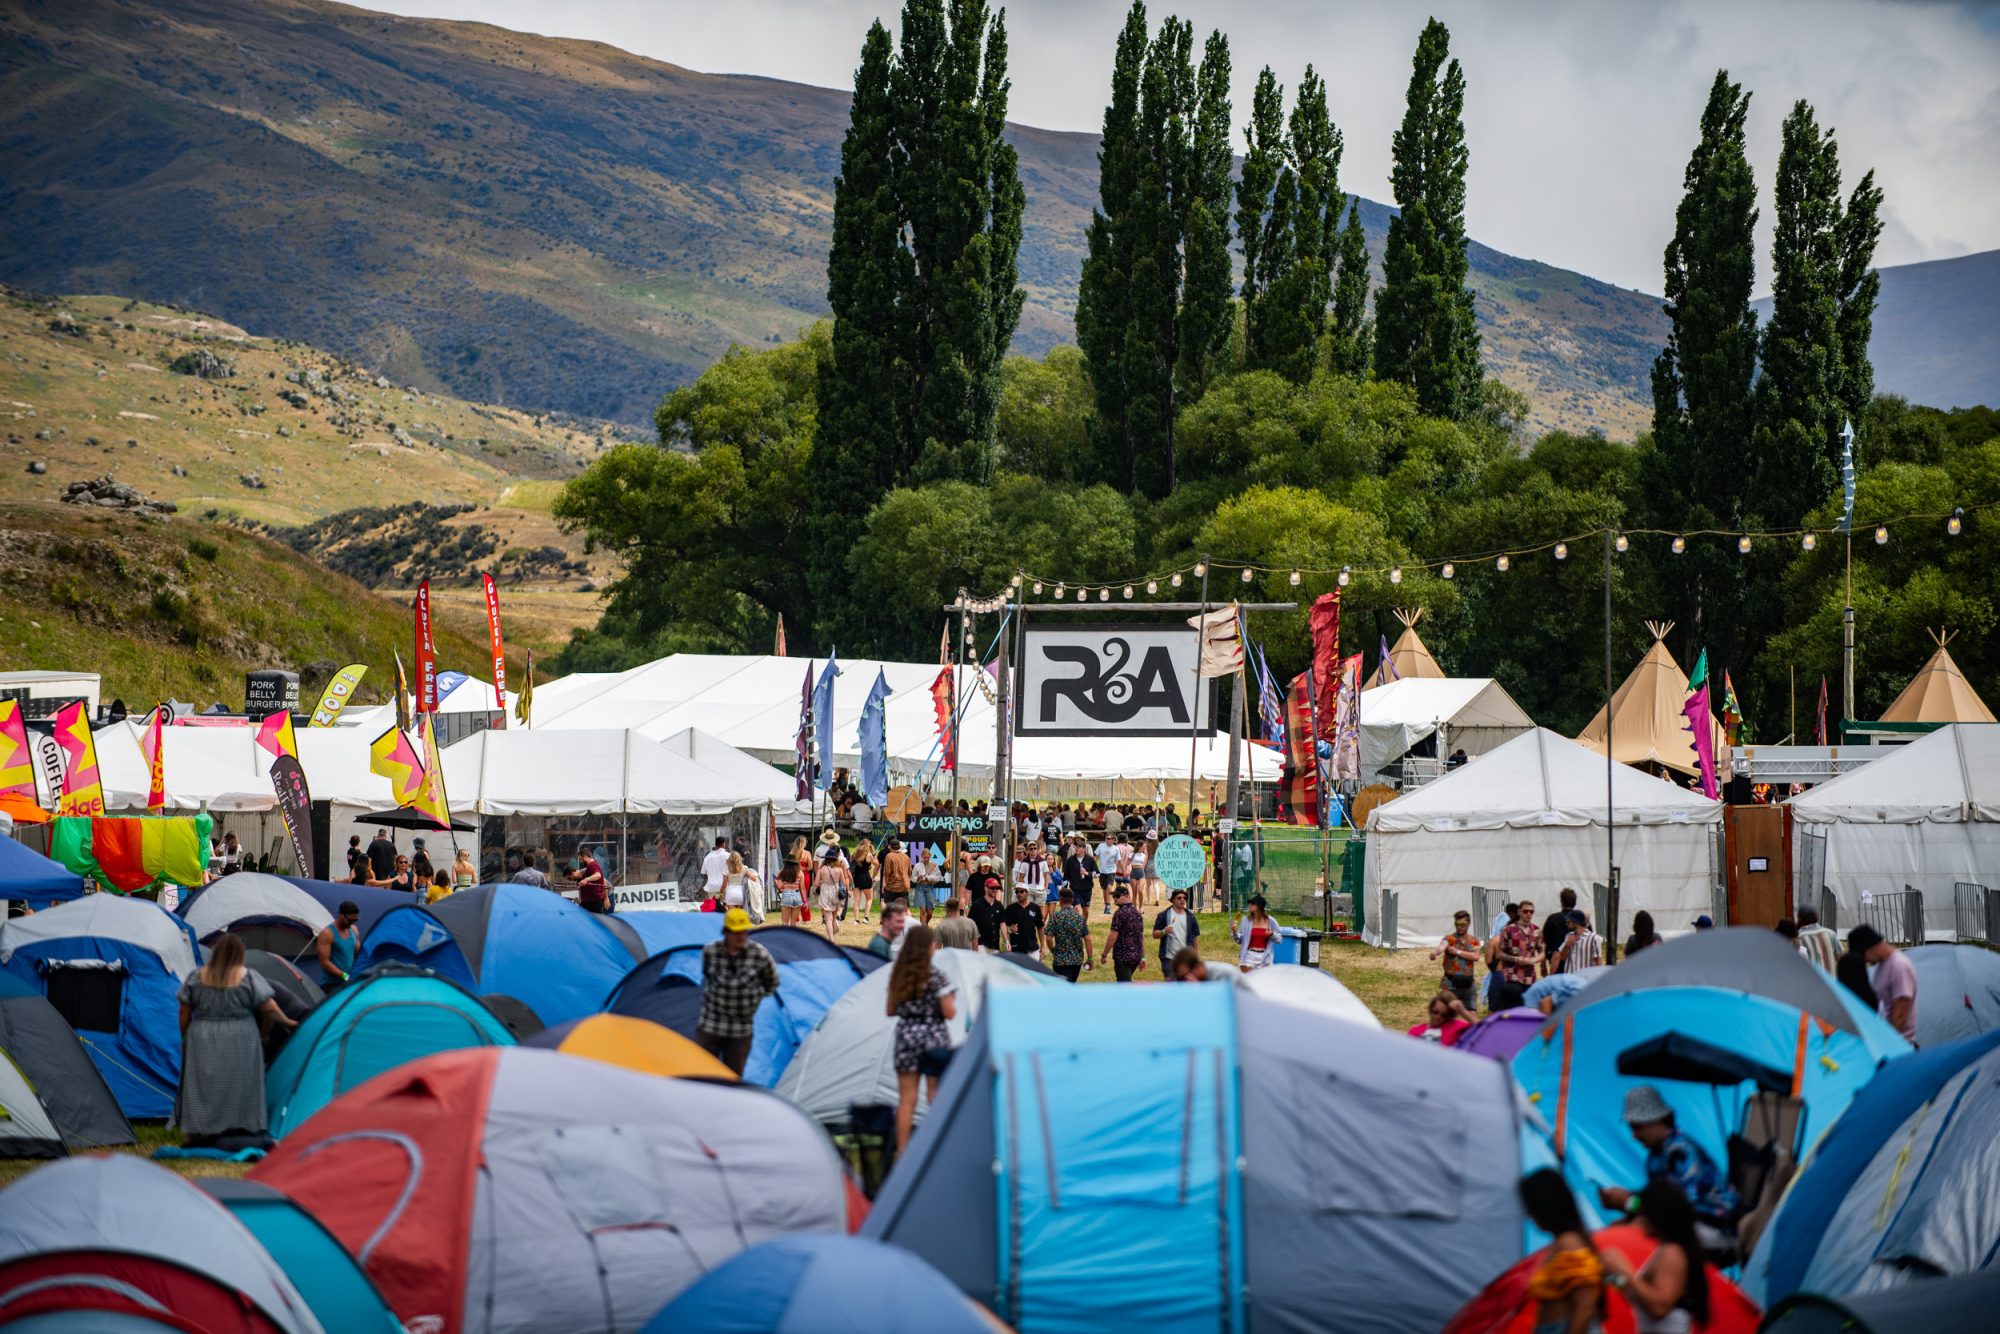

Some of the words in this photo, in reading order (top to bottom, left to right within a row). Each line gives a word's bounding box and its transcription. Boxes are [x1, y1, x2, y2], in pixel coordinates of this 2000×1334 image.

[251, 681, 276, 690] PORK
[424, 662, 434, 704] FREE
[249, 691, 277, 699] BELLY
[245, 700, 281, 709] BURGER
[309, 682, 348, 728] DON
[60, 797, 102, 816] dge
[1165, 840, 1176, 849] WE
